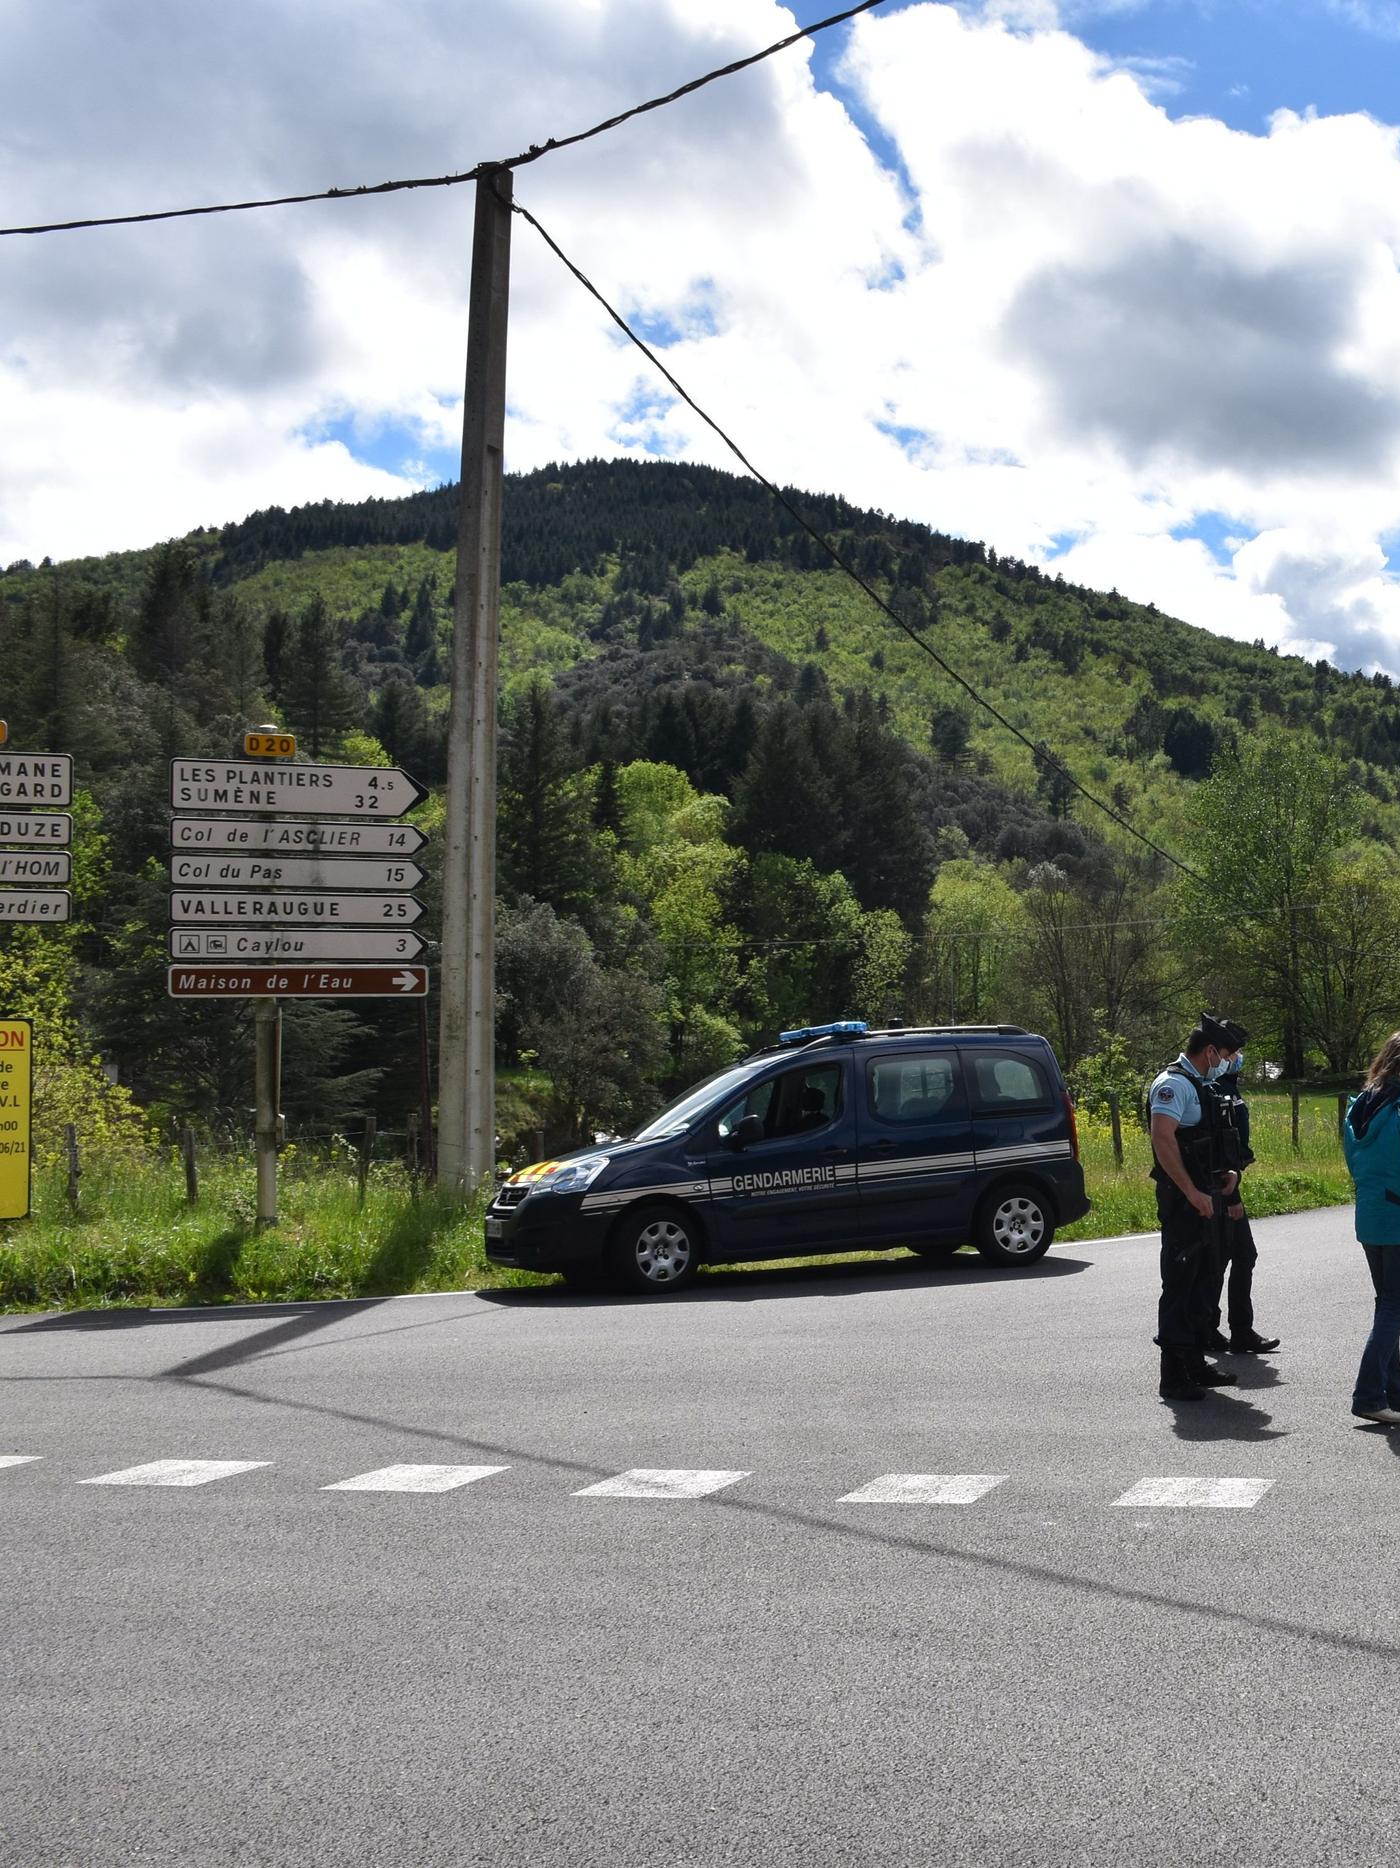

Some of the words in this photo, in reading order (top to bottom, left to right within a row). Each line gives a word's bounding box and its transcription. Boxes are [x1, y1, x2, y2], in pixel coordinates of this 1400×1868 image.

[180, 768, 216, 782] LES
[226, 770, 333, 788] PLANTIERS
[1, 782, 62, 798] GARD
[180, 787, 276, 805] SUMÈNE
[354, 795, 379, 809] 32
[0, 822, 61, 837] DUZE
[181, 827, 212, 841] Col
[227, 828, 249, 842] de
[388, 833, 406, 846] 14
[1, 860, 60, 876] l'HOM
[178, 863, 210, 877] Col
[220, 864, 241, 878] du
[250, 864, 283, 879] Pas
[386, 868, 405, 882] 15
[180, 900, 339, 916] VALLERAUGUE
[383, 904, 407, 917] 25
[237, 937, 304, 954] Caylou
[396, 939, 407, 952] 3
[179, 975, 251, 989] Maison
[267, 974, 289, 989] de
[303, 974, 353, 989] l'Eau
[733, 1165, 835, 1191] GENDARMERIE
